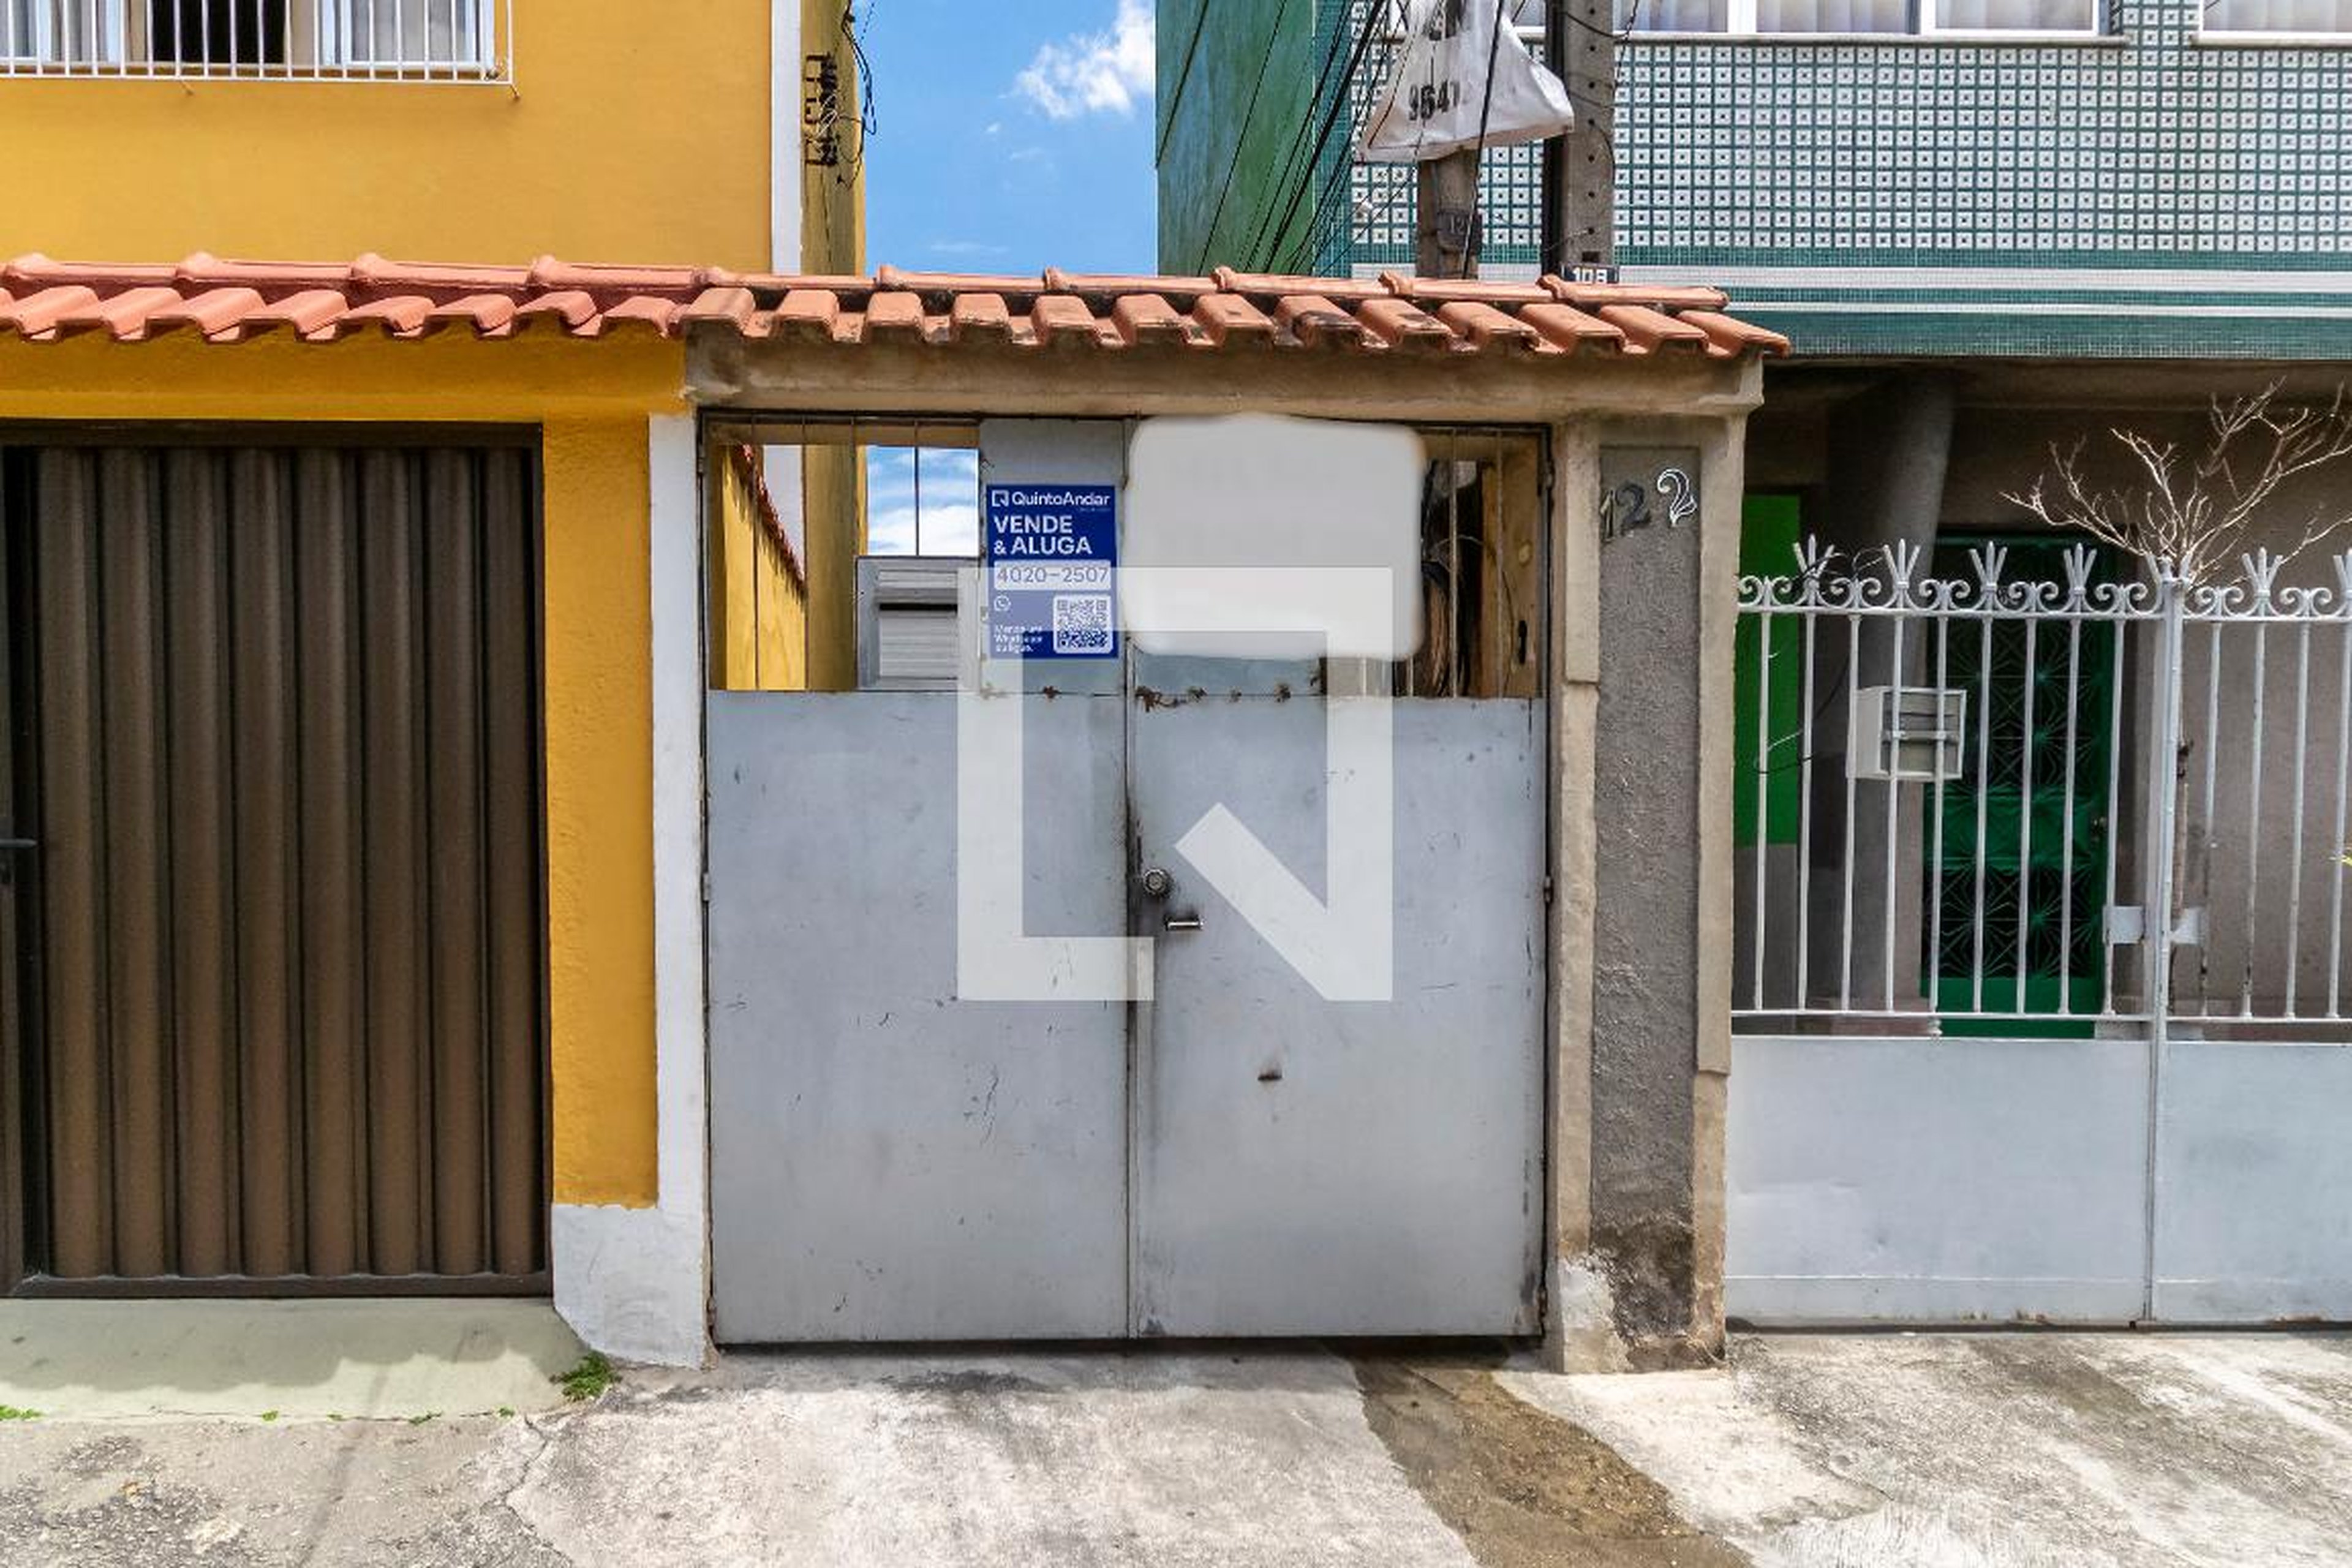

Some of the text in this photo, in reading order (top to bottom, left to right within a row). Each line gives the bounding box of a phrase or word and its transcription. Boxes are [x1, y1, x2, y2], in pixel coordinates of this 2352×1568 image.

[1012, 492, 1110, 506] QuintoAndar
[994, 515, 1072, 533] VENDE
[994, 536, 1093, 555] & ALUGA
[997, 567, 1109, 583] 4020-2507
